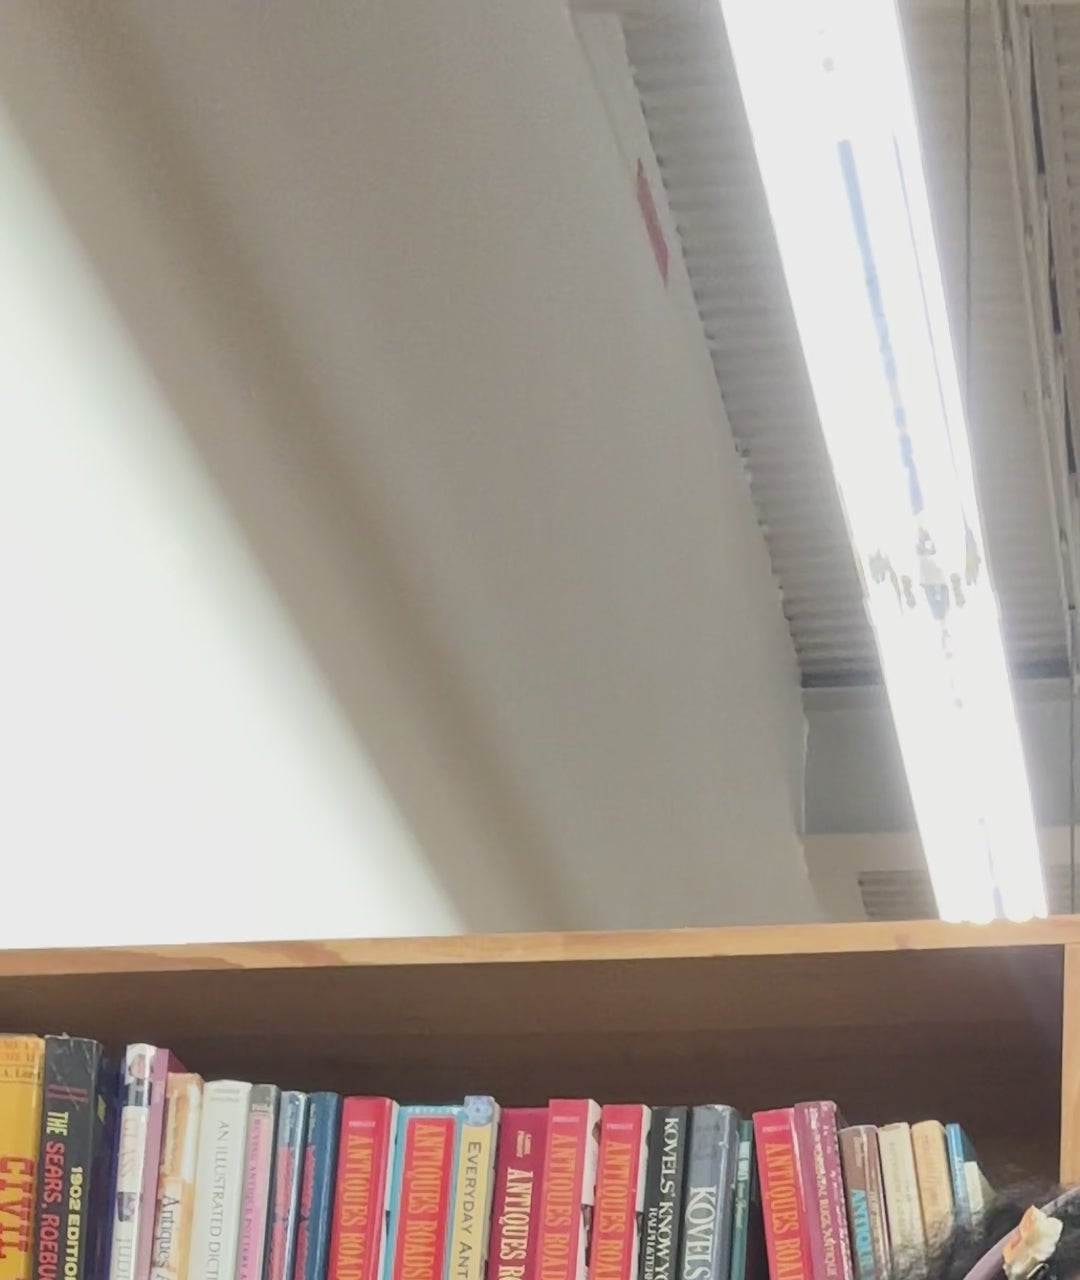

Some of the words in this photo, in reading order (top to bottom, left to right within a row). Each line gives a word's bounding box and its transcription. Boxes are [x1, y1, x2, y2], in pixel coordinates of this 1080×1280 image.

[46, 1112, 69, 1136] THE
[210, 1121, 230, 1141] AN
[42, 1140, 65, 1208] SEARS,
[69, 1166, 83, 1211] 1902
[208, 1147, 229, 1238] ILLUSTRATED
[407, 1123, 446, 1214] ANTIQUES
[461, 1141, 482, 1235] EVERYDAY
[765, 1143, 799, 1235] ANTIQUES
[157, 1195, 180, 1268] Antiques
[499, 1167, 534, 1261] ANTIQUES
[655, 1201, 674, 1251] KNOW
